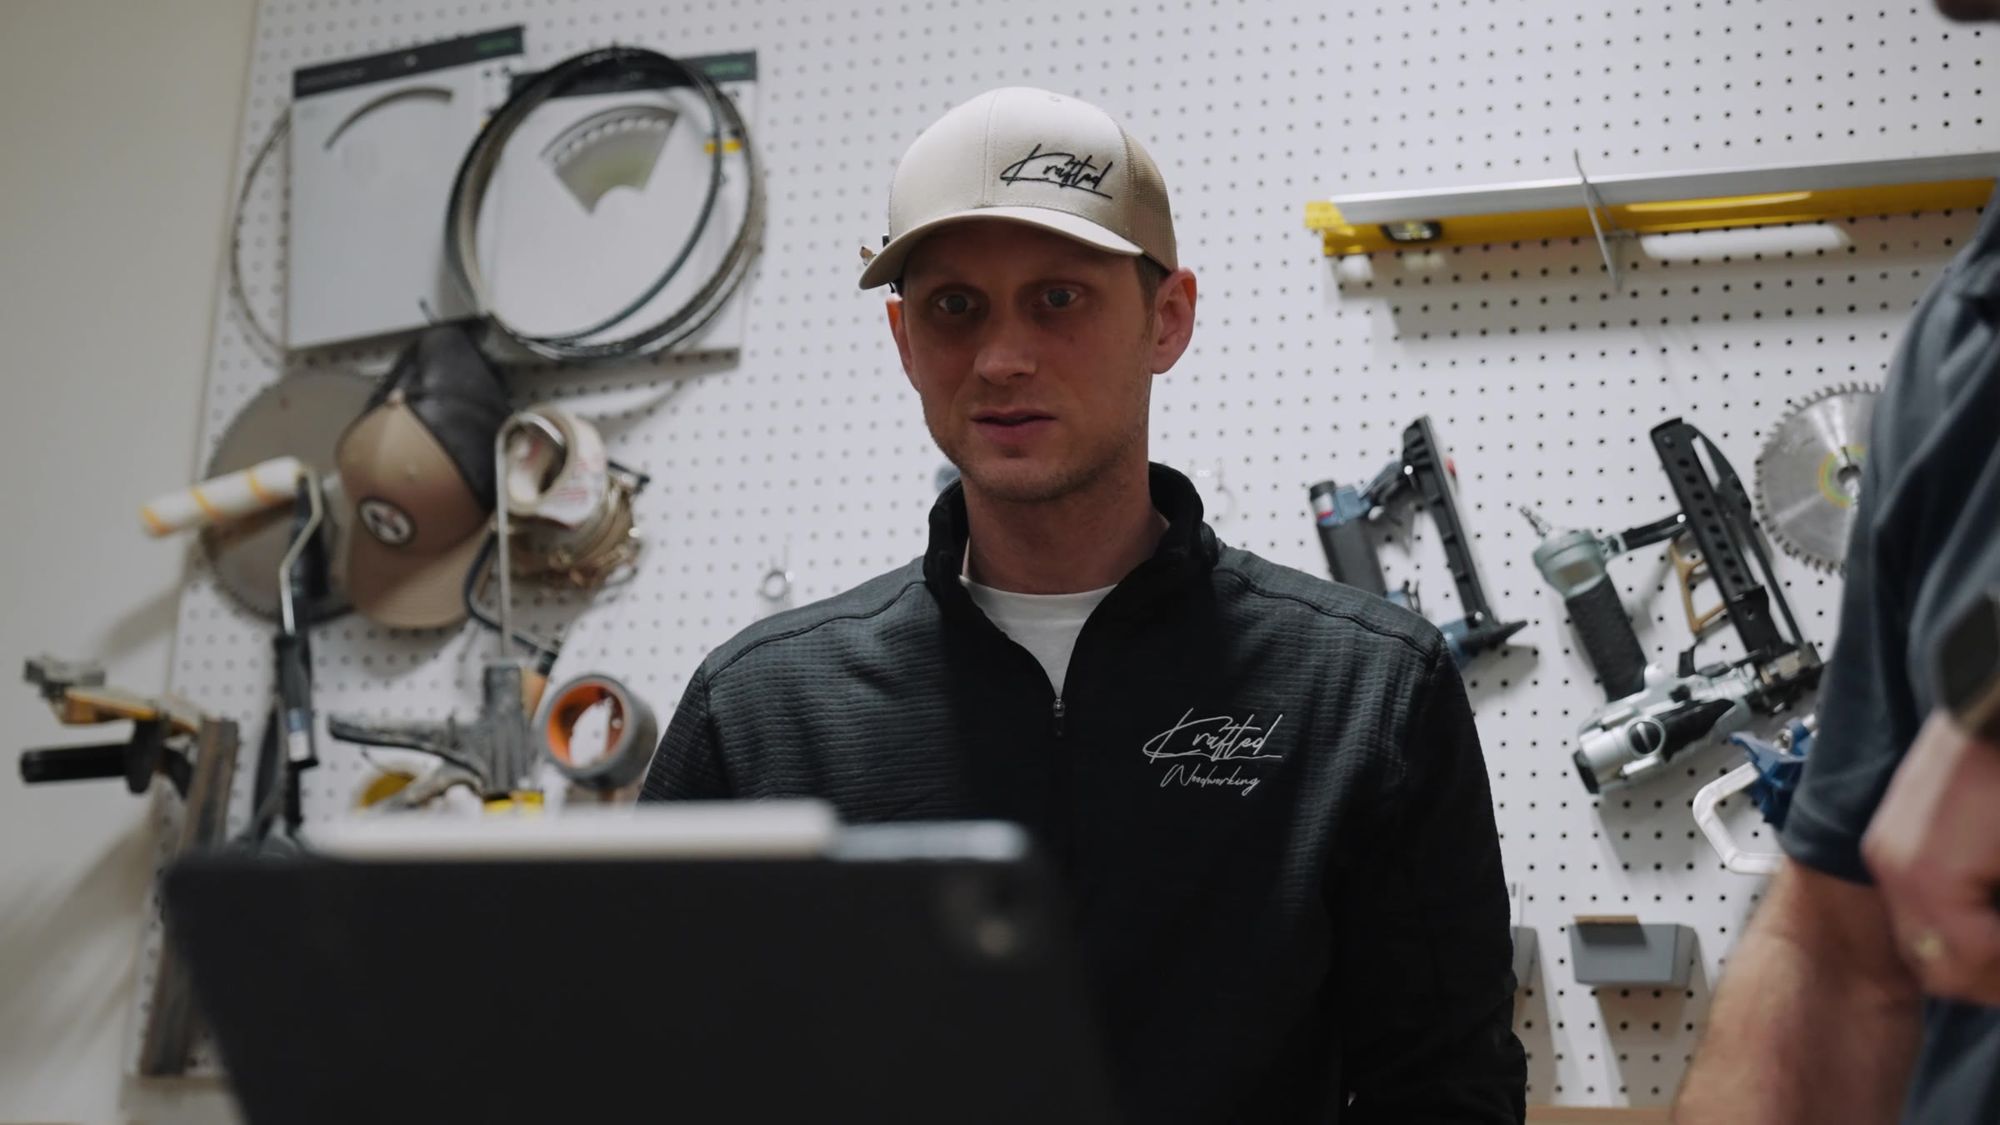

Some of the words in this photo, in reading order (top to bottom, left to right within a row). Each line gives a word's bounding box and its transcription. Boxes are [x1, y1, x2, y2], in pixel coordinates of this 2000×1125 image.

[1000, 143, 1113, 199] Krafted
[1142, 707, 1284, 764] Krafted
[1160, 763, 1261, 797] Woodworking
